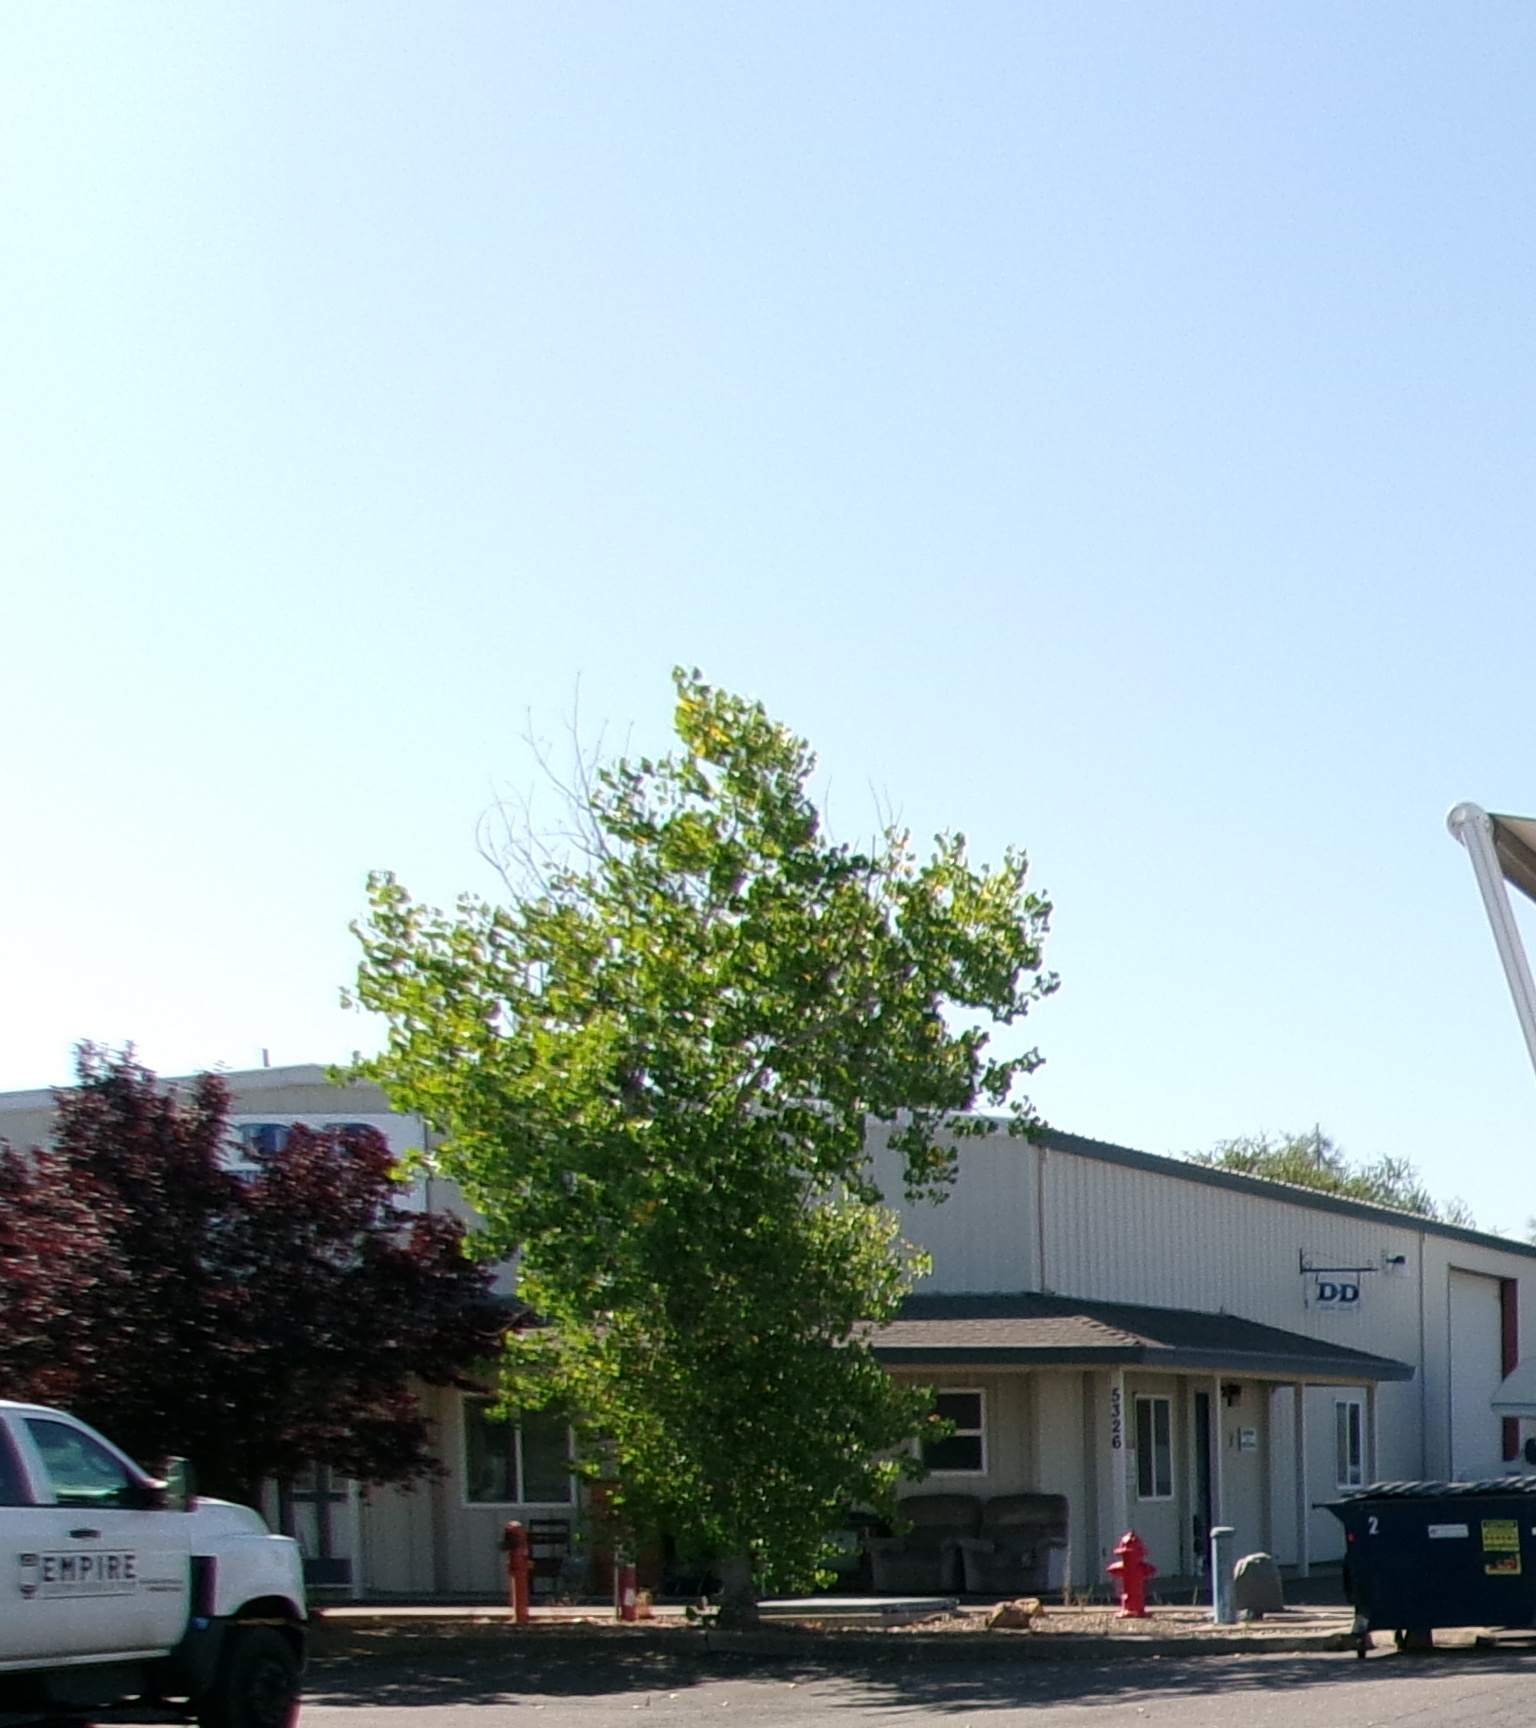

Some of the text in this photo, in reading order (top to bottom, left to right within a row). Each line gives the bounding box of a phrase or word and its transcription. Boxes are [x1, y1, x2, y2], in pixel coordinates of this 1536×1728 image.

[1111, 1387, 1122, 1449] 5326
[1368, 1515, 1379, 1535] 2
[42, 1553, 137, 1582] EMPIRE
